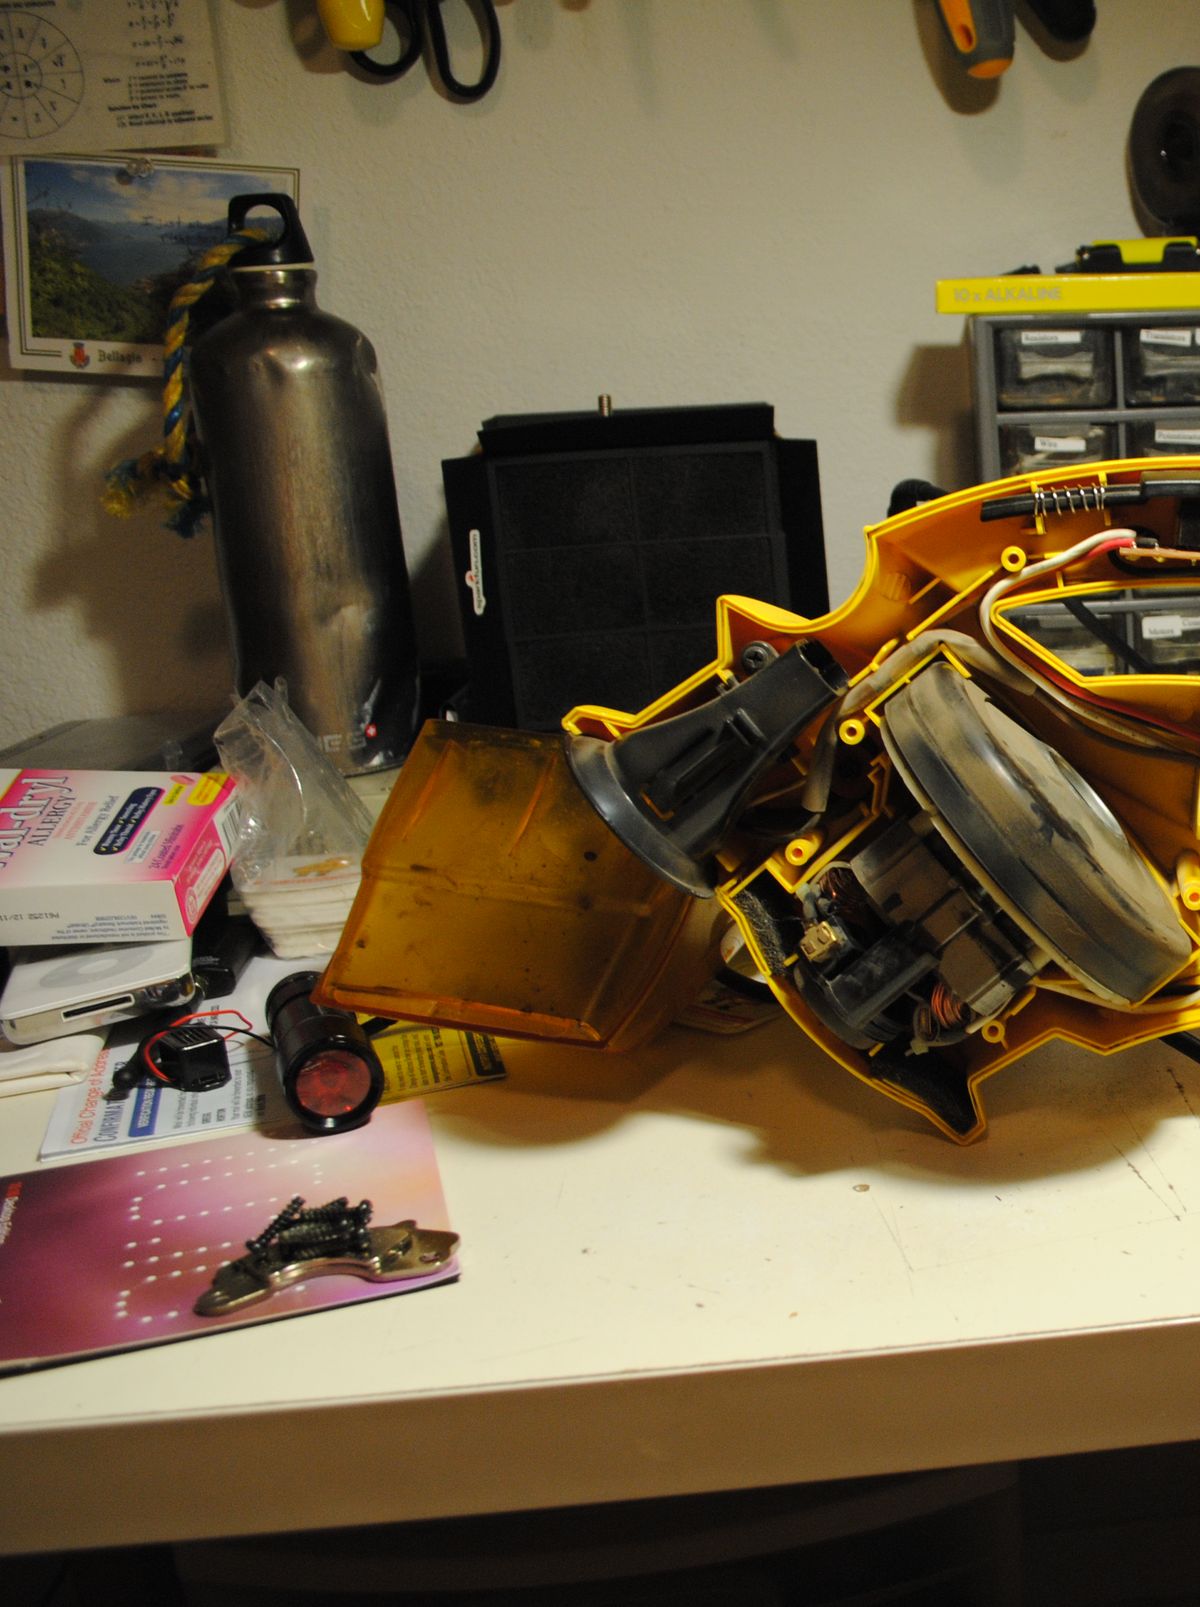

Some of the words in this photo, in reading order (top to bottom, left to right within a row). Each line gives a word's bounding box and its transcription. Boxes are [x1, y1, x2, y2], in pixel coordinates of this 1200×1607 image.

[984, 287, 1062, 302] ALKALINE
[26, 795, 77, 847] ALLERGY
[84, 808, 109, 837] Allergy
[78, 1086, 104, 1120] Change
[70, 1117, 93, 1146] Official
